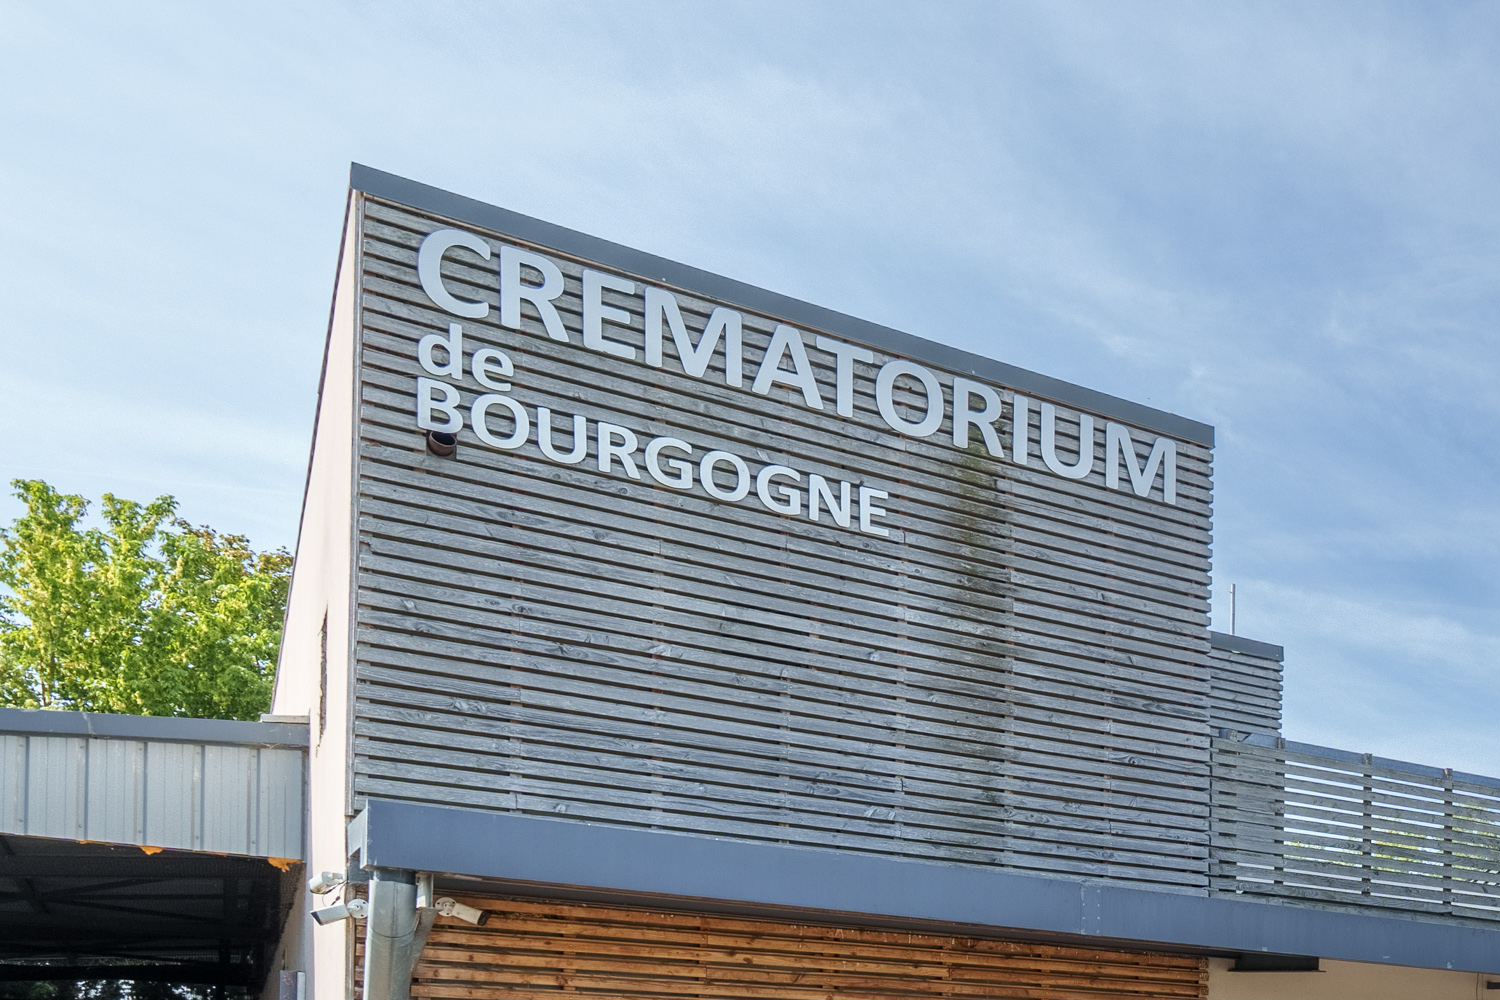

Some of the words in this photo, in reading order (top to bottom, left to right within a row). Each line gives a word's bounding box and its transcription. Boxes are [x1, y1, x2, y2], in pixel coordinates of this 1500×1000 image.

[416, 322, 515, 393] de
[416, 228, 1178, 506] CREMATORIUM
[415, 375, 892, 538] BOURGOGNE
